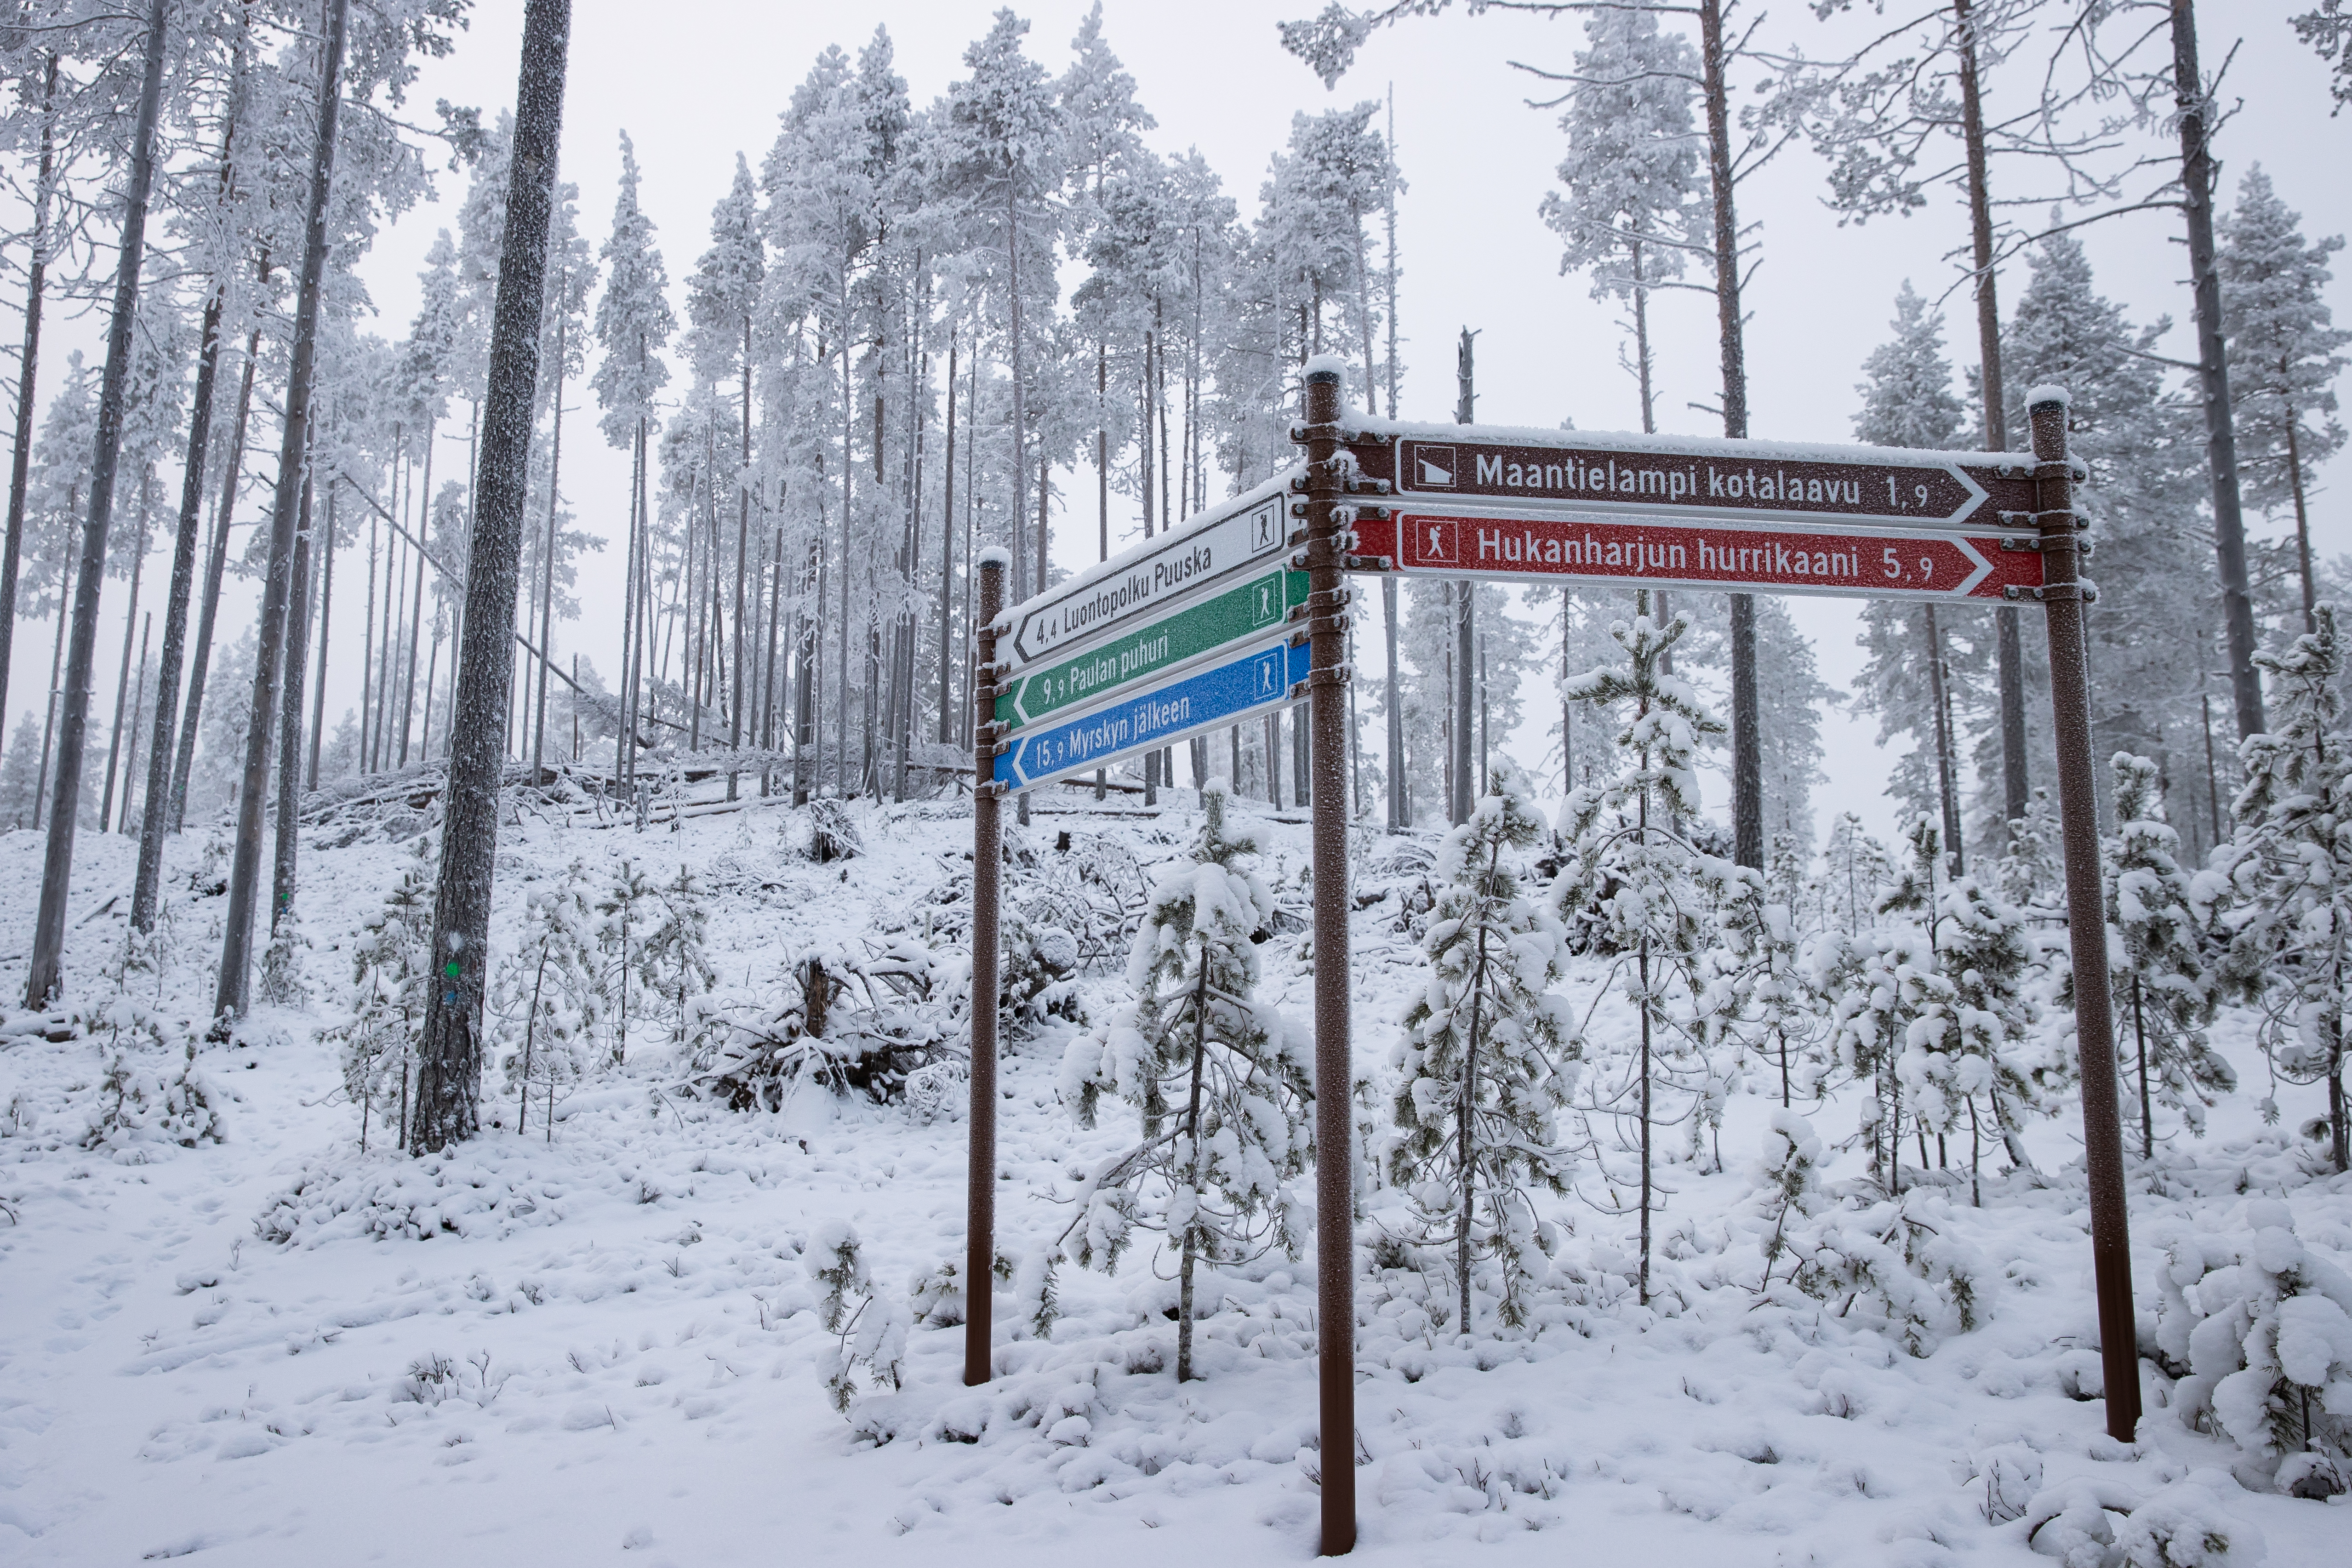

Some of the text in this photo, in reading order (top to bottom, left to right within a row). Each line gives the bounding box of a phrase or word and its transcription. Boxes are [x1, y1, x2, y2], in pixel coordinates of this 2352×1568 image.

[1476, 454, 1928, 509] Maantielampi kotalaavu 1,9
[1479, 529, 1932, 581] Hukanharjun hurrikaani 5,9
[1036, 546, 1212, 646] 4,4 Luontopolku Puuska
[1044, 629, 1169, 705] 9,9 Paulan puhuri
[1036, 697, 1190, 769] 15,9 Myrskyn jälkeen
